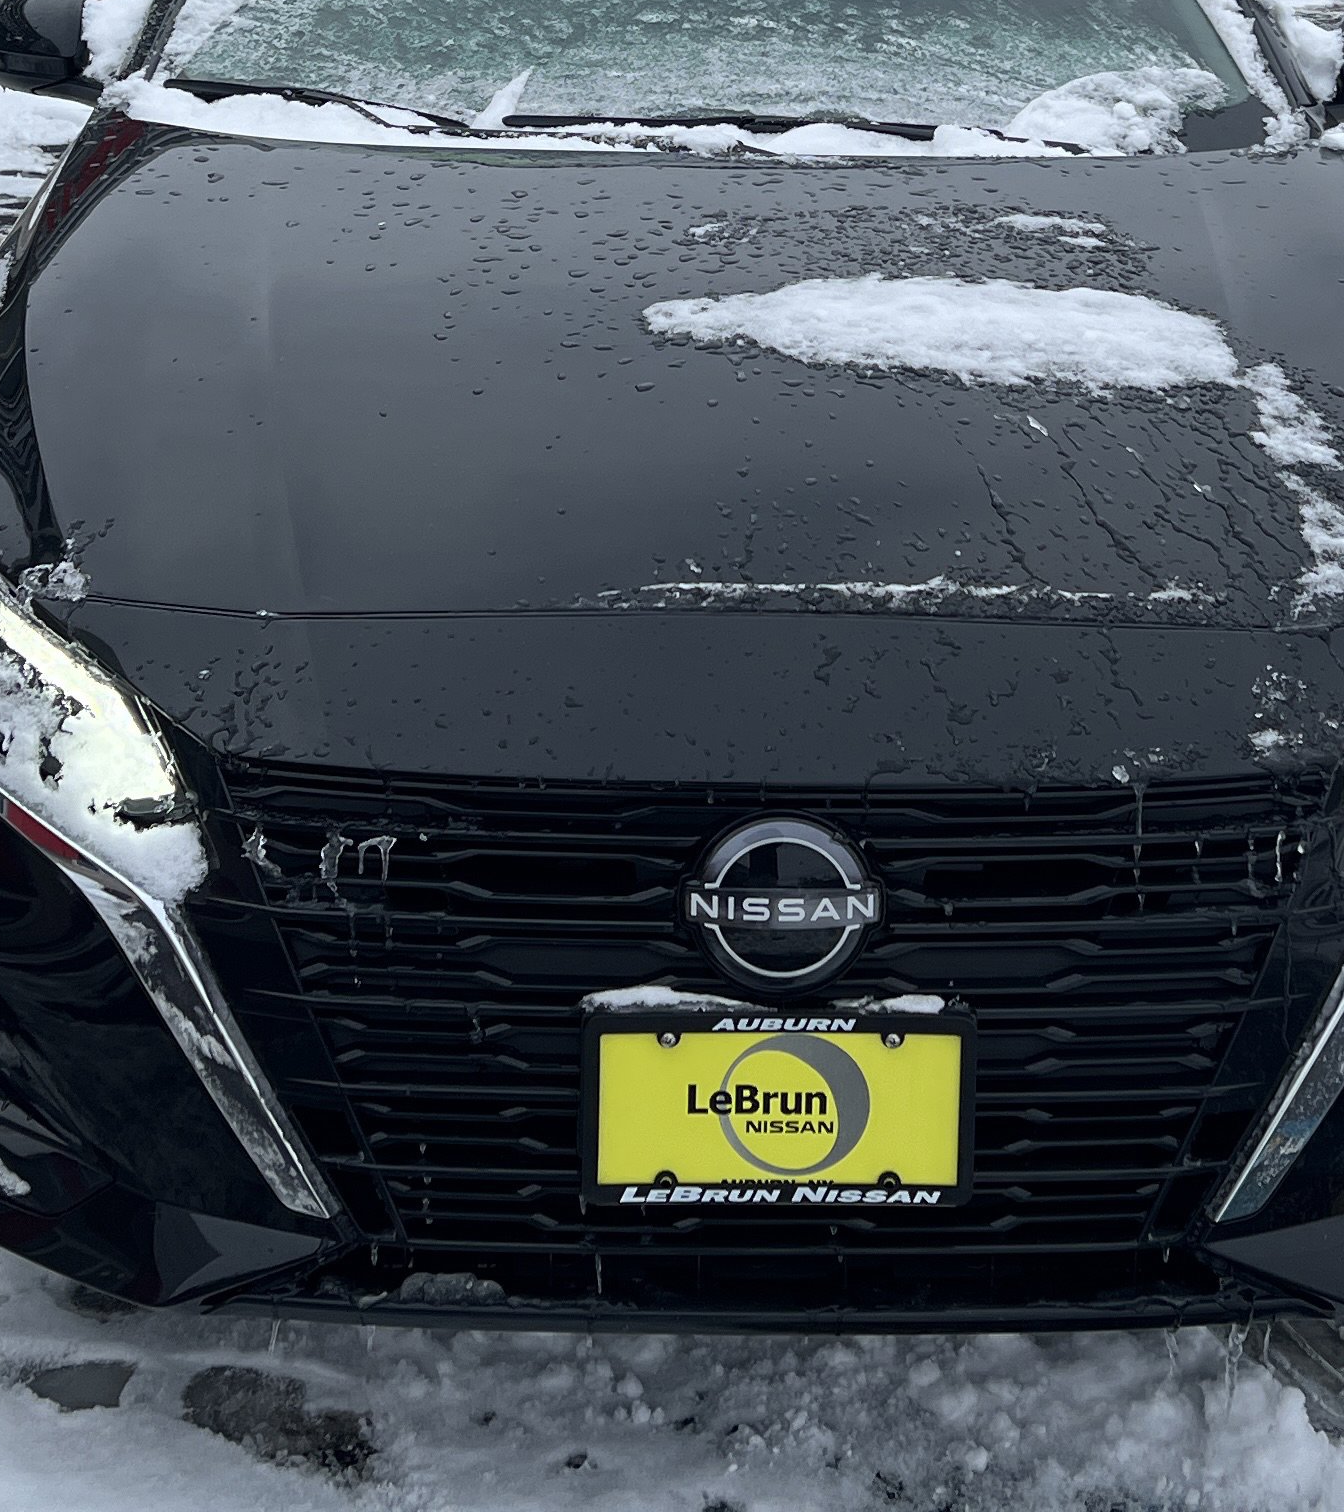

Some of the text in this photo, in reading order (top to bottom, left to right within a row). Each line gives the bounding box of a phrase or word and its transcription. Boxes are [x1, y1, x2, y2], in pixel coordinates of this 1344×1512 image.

[690, 892, 875, 922] NISSAN
[711, 1017, 857, 1032] AUBURN
[687, 1084, 828, 1115] LeBrun
[745, 1120, 834, 1134] NISSAN
